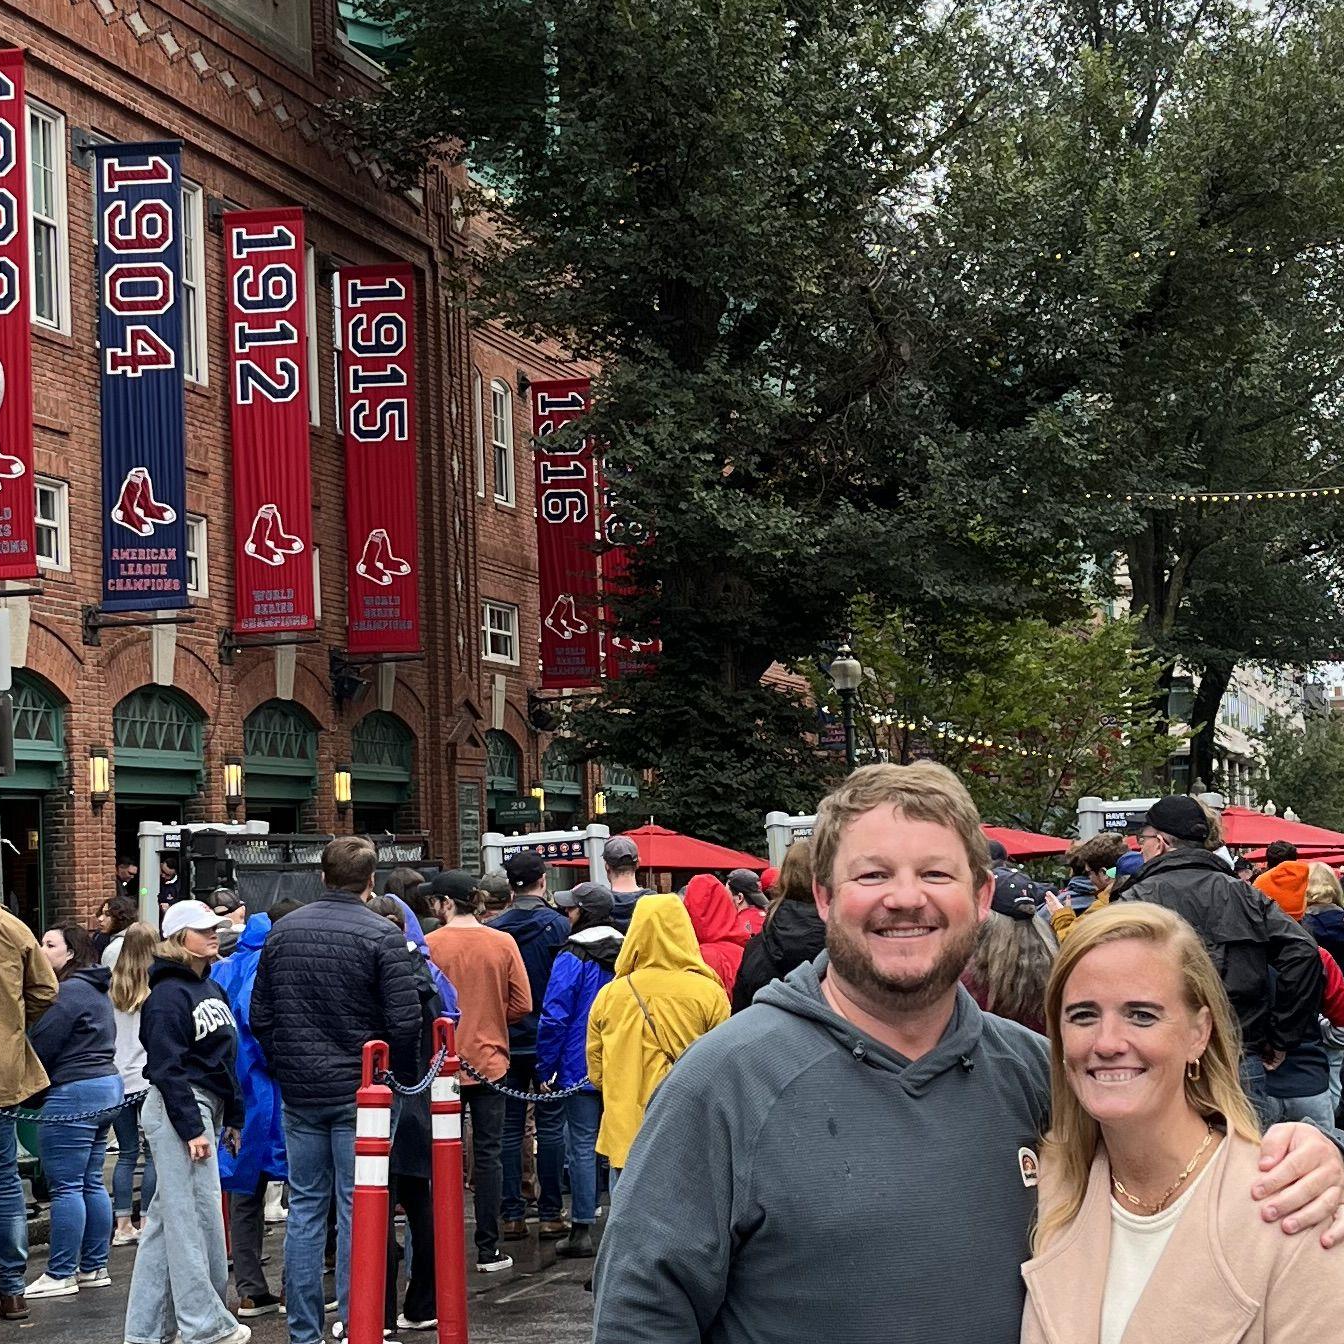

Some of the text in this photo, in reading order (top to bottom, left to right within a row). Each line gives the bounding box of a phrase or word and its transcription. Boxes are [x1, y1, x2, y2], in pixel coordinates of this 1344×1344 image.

[102, 155, 176, 378] 1904
[231, 224, 299, 406] 1912
[347, 276, 408, 443] 1915
[111, 548, 177, 561] AMERICAN
[120, 563, 168, 576] LEAGUE
[107, 578, 181, 592] CHAMPIONS
[510, 800, 527, 810] 20
